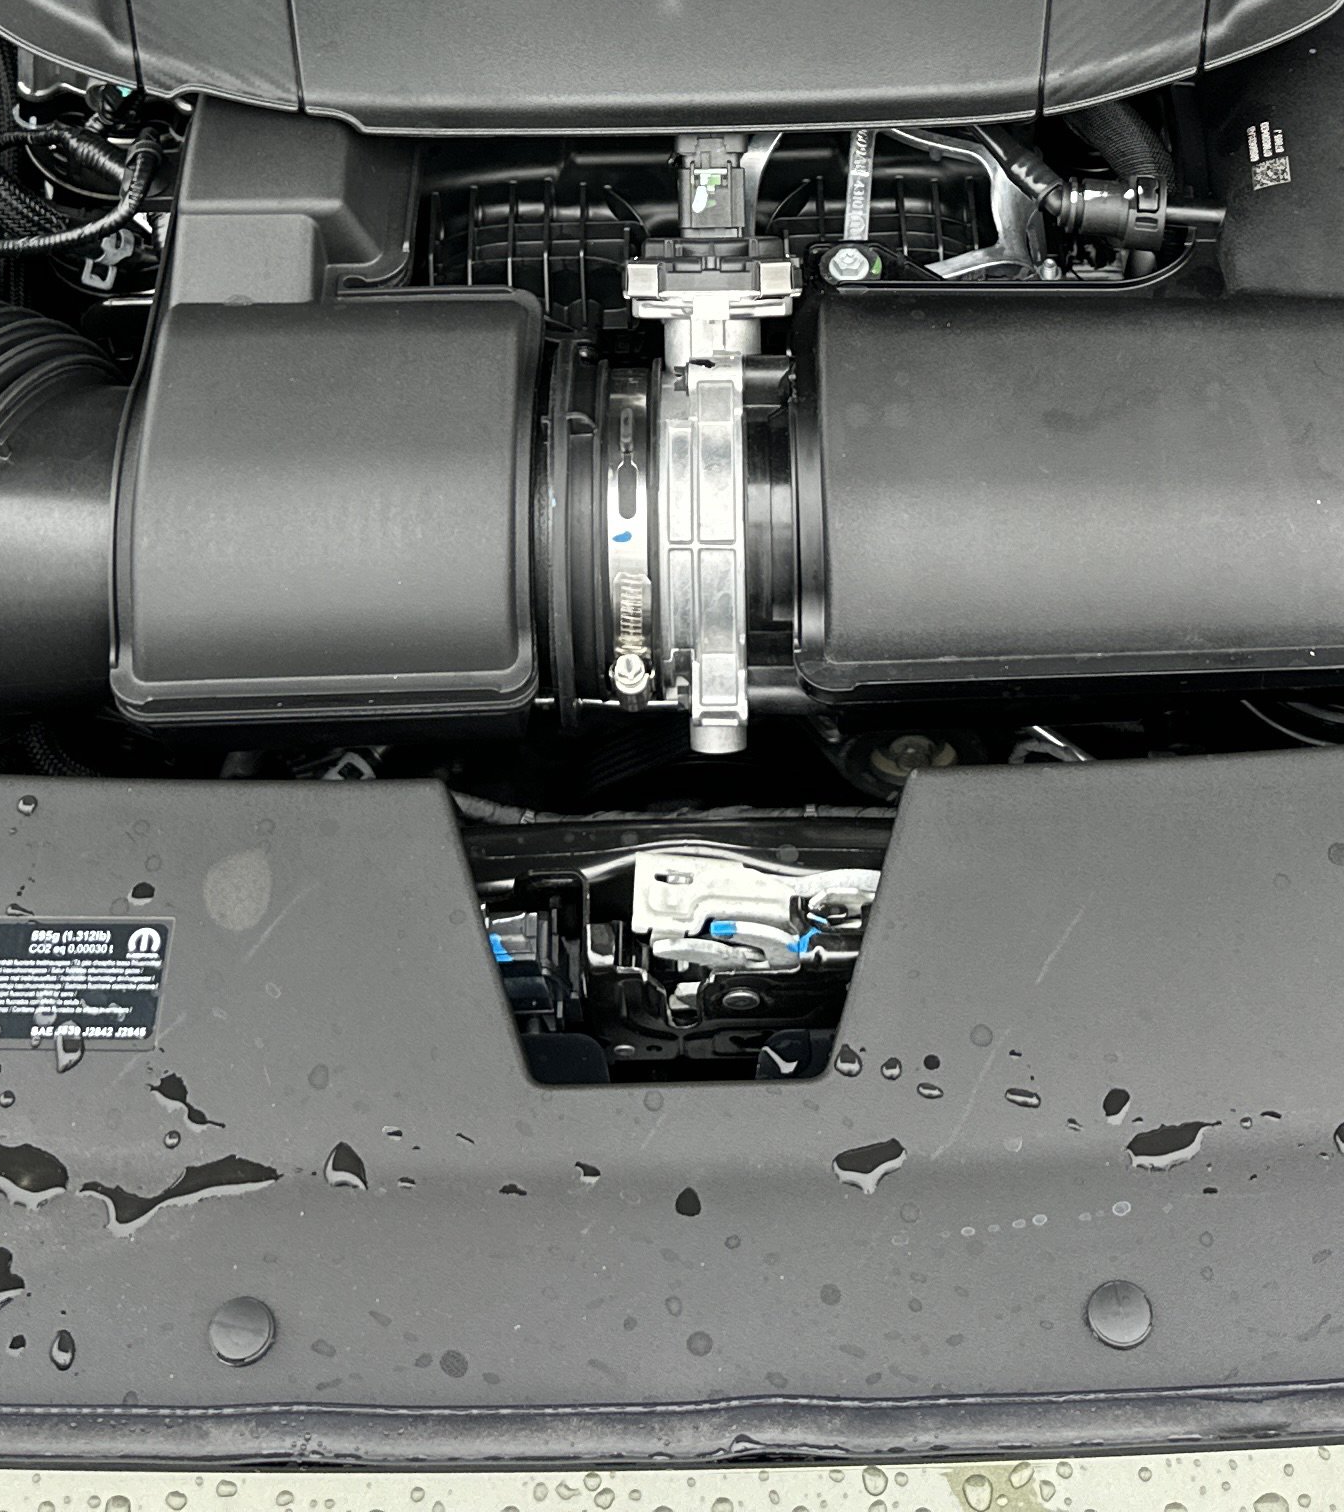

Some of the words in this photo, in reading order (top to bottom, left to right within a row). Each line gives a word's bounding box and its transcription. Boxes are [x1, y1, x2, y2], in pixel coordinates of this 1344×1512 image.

[28, 944, 53, 954] CO2
[52, 945, 66, 956] eq
[30, 1026, 54, 1037] SAE
